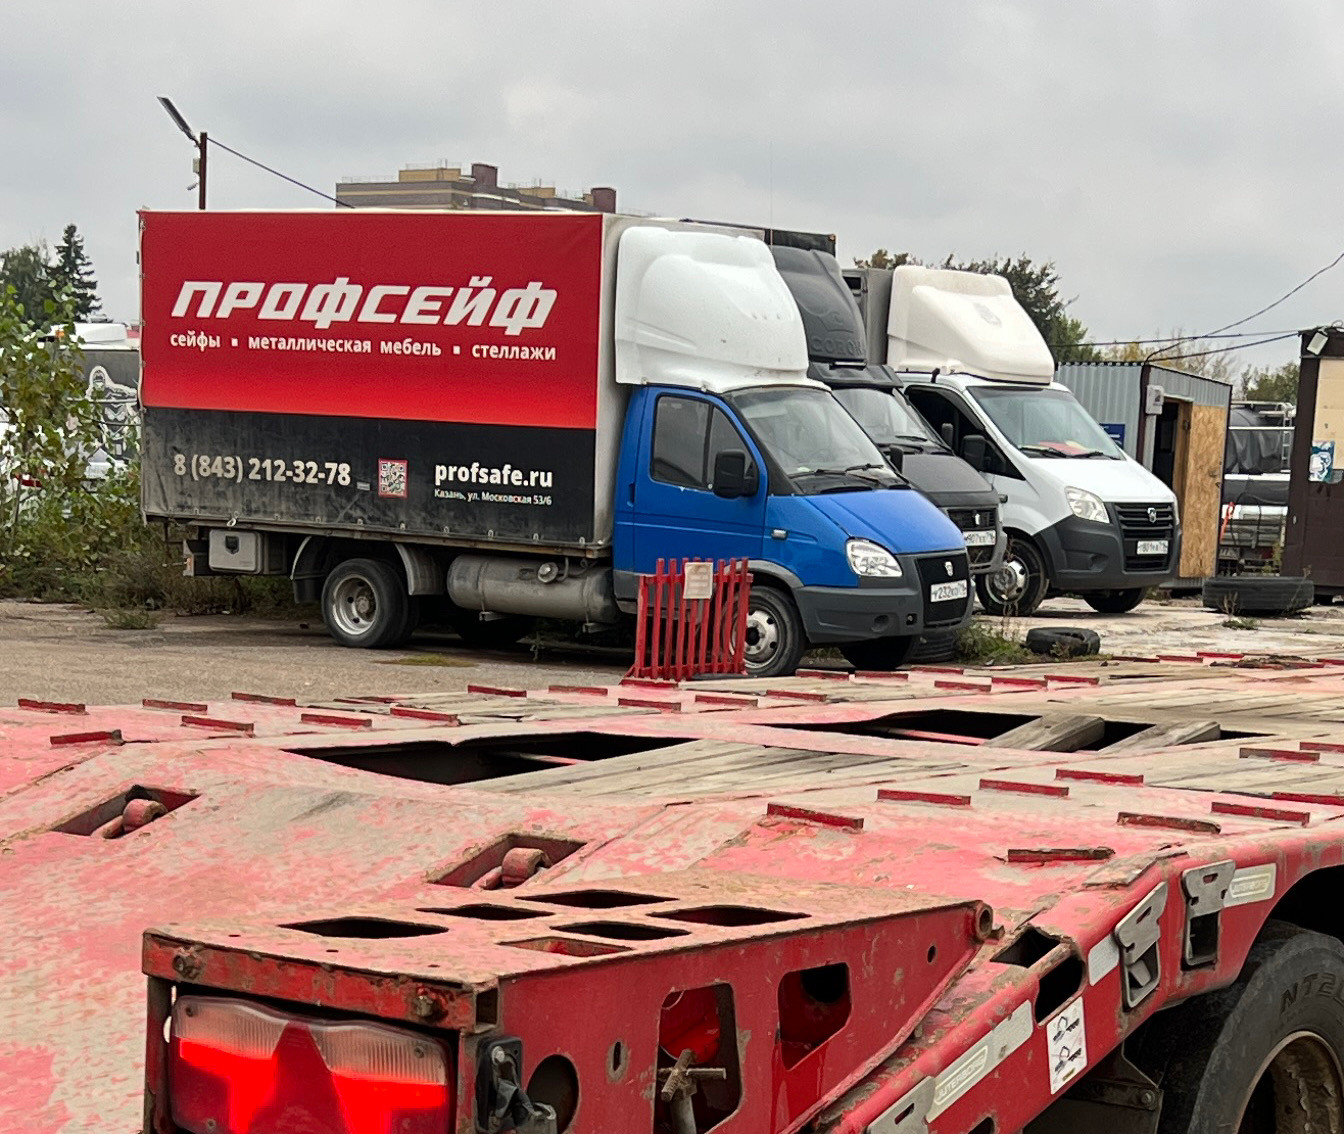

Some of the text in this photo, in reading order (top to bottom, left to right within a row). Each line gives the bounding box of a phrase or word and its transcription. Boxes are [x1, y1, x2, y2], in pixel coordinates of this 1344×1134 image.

[170, 276, 558, 336] ПРОФСЕЙФ
[170, 330, 557, 361] сейфы металлическая мебель стеллажи
[174, 453, 351, 486] 8 (843) 212-32-78
[435, 462, 553, 487] profsafe.ru
[434, 488, 467, 501] Казань,
[481, 492, 532, 505] Московская
